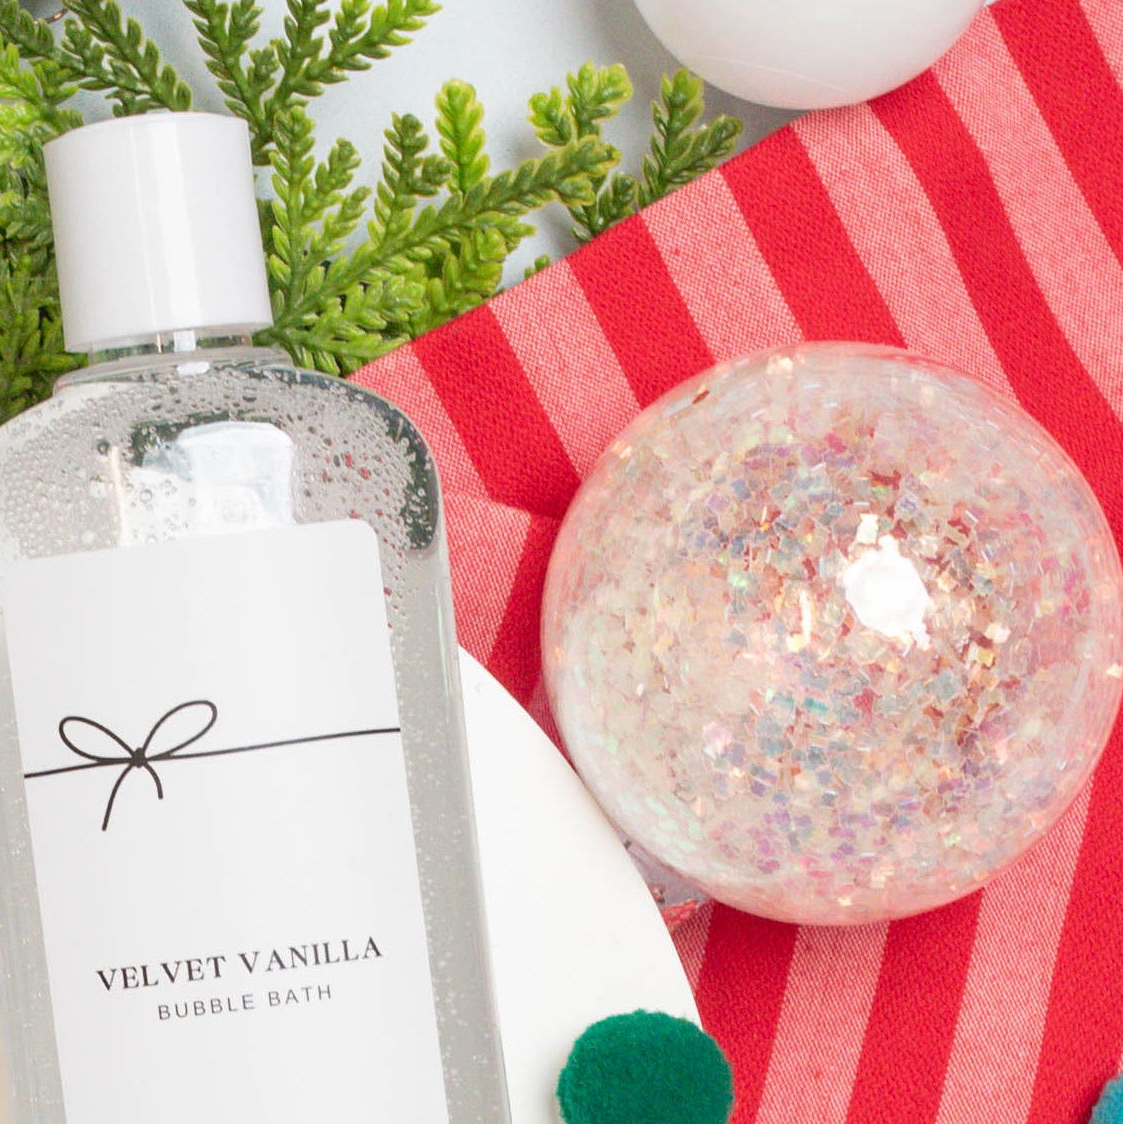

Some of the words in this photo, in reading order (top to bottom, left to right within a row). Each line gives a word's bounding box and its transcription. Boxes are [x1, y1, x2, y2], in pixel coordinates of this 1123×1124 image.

[95, 955, 227, 992] VELVET
[236, 935, 384, 975] VANILLA
[157, 993, 256, 1021] BUBBLE
[267, 983, 332, 1008] BATH
